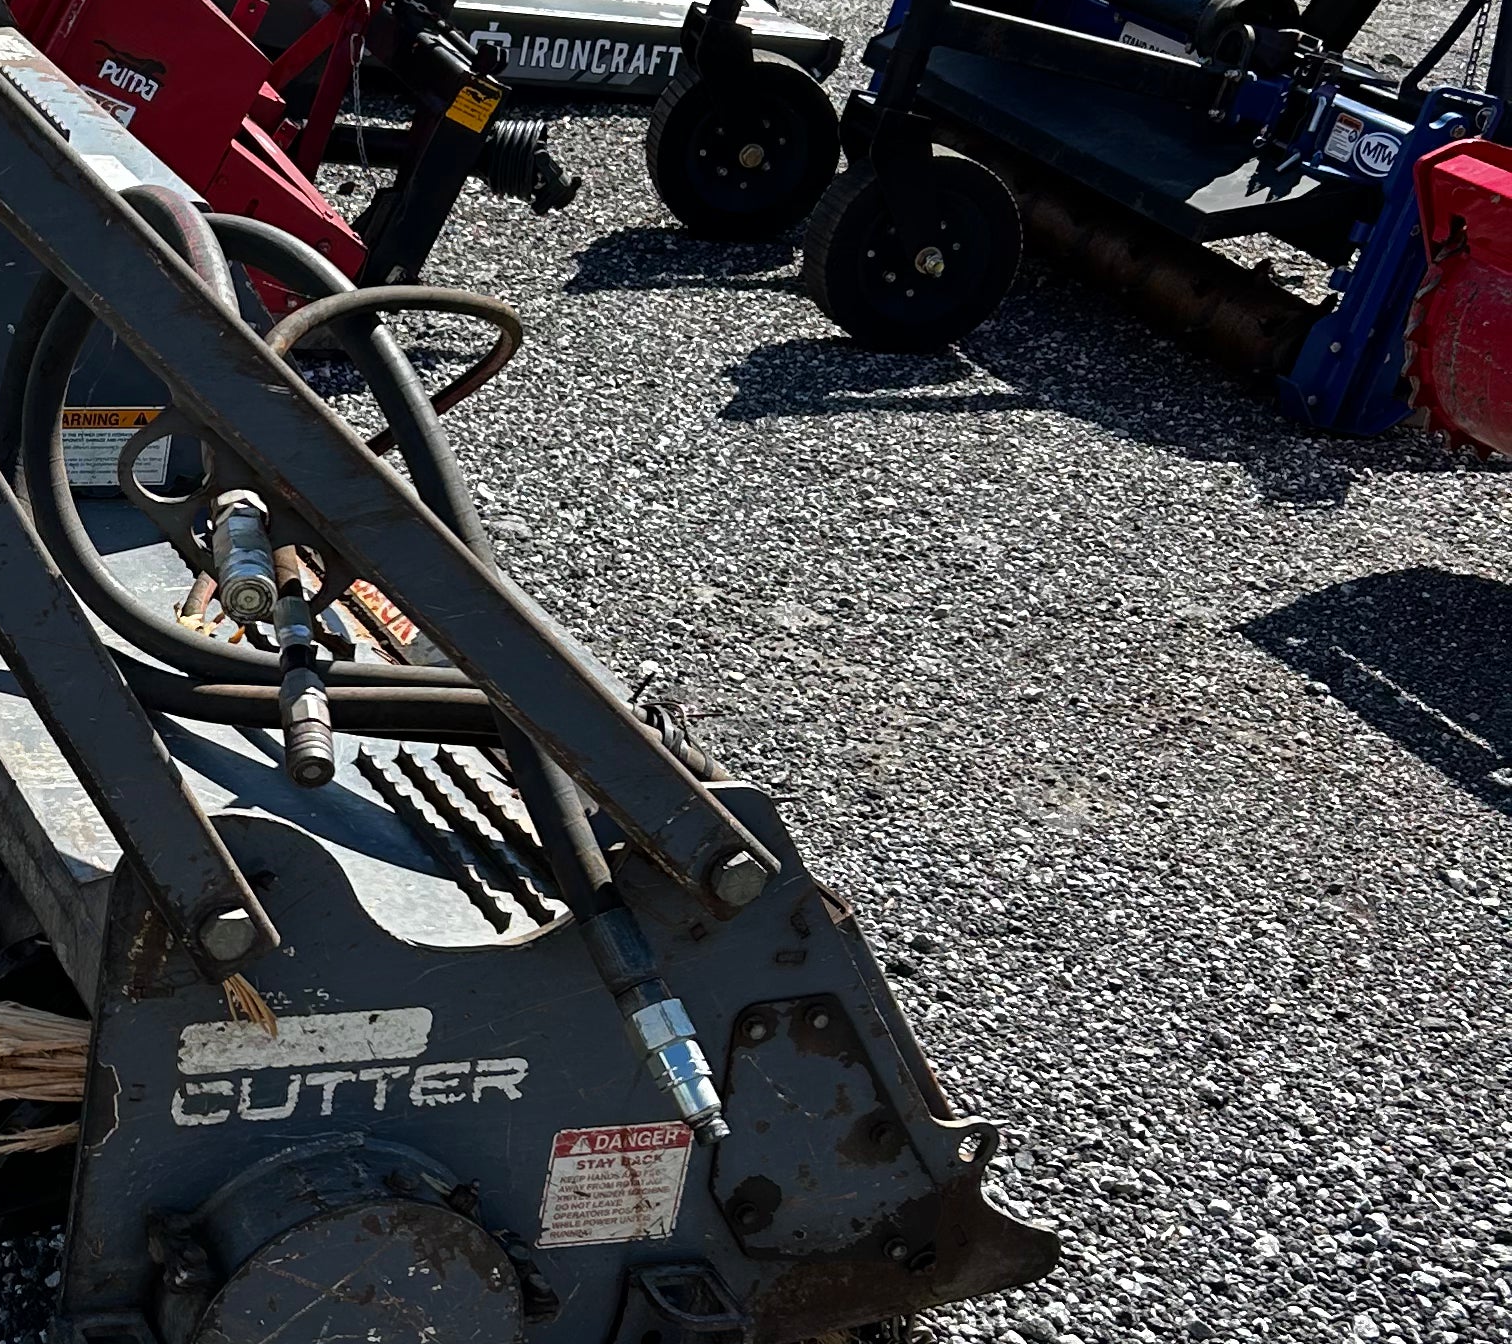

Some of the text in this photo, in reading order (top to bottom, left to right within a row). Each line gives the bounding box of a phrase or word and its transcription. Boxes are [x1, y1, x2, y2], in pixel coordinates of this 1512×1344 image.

[519, 35, 683, 77] IRONCRAFT
[62, 413, 120, 426] ARNING
[171, 1057, 529, 1127] CUTTER
[594, 1130, 679, 1150] DANGER
[576, 1154, 664, 1170] STAY BACK
